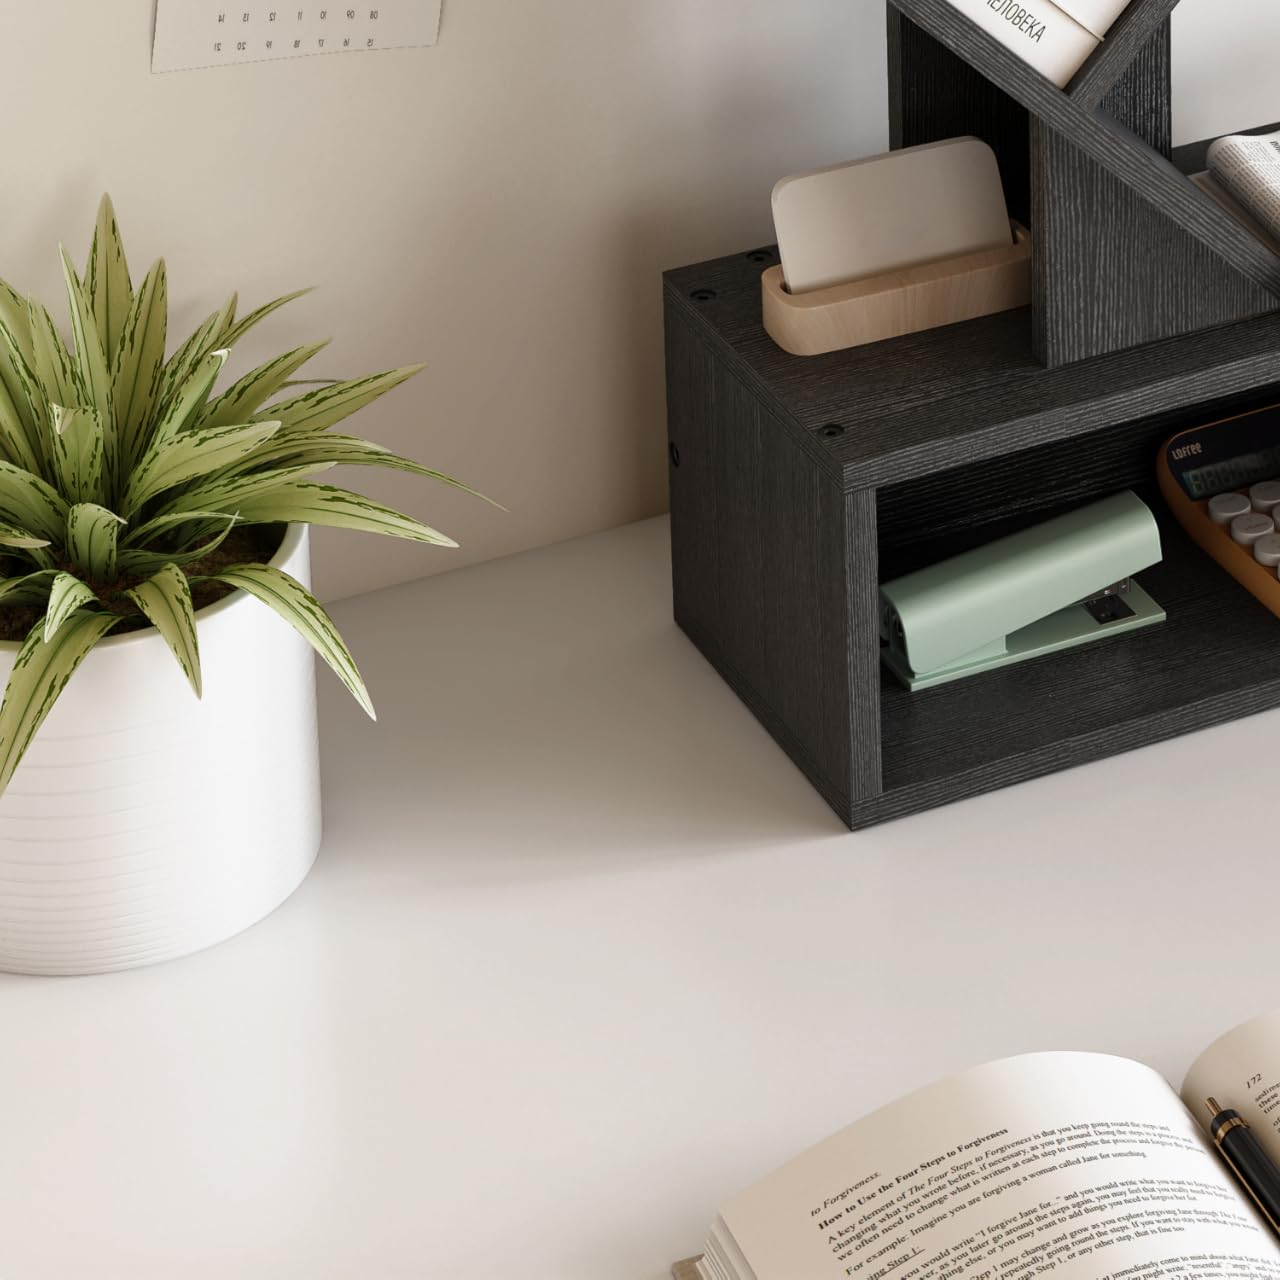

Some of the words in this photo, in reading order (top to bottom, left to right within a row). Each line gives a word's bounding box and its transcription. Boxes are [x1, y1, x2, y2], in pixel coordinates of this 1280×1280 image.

[1245, 1073, 1263, 1089] 172
[818, 1211, 843, 1231] How
[845, 1204, 857, 1214] to
[857, 1191, 877, 1206] Use
[878, 1181, 894, 1195] the
[895, 1168, 919, 1184] Four
[919, 1154, 946, 1171] Steps
[947, 1148, 957, 1160] to
[957, 1128, 1009, 1153] Forgiveness
[828, 1235, 838, 1245] A
[837, 1222, 857, 1239] key
[858, 1200, 895, 1225] element
[896, 1192, 908, 1202] of
[907, 1181, 926, 1196] The
[927, 1171, 949, 1186] Four
[950, 1157, 974, 1174] Steps
[975, 1153, 984, 1163] to
[984, 1137, 1032, 1159] Forgiveness
[845, 1260, 864, 1276] For
[910, 1213, 948, 1238] Imagine
[949, 1203, 967, 1218] you
[967, 1196, 982, 1207] are
[982, 1177, 1022, 1200] forgiving
